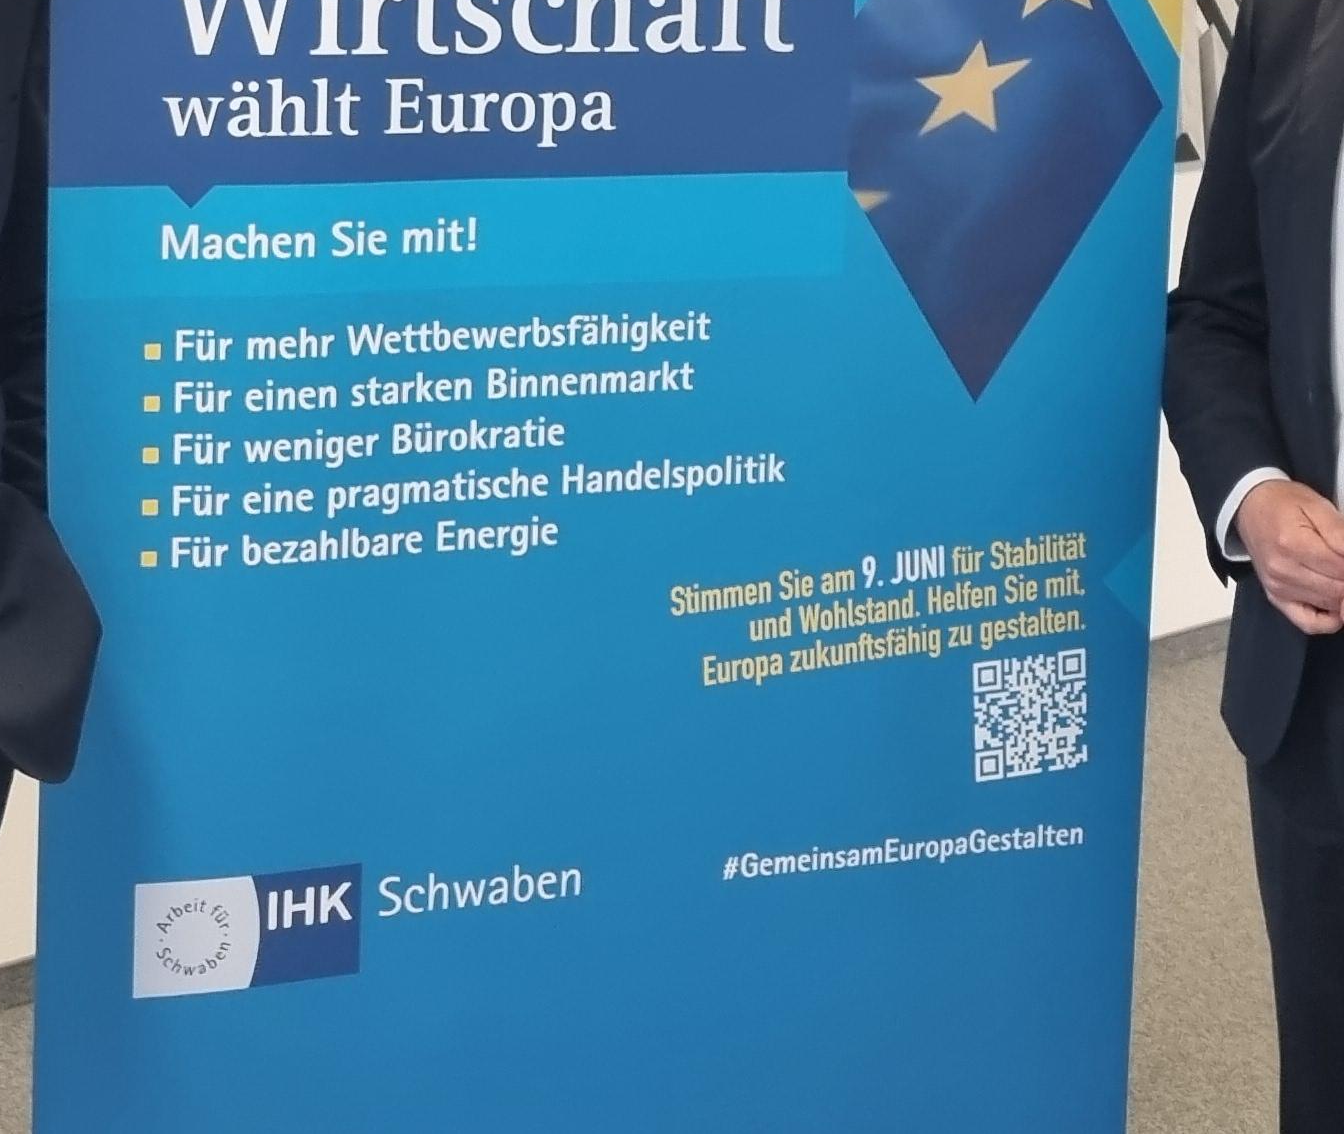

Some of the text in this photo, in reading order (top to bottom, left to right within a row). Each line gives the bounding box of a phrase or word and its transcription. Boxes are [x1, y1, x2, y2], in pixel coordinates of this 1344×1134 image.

[164, 78, 615, 147] wählt Europa
[161, 217, 478, 260] Machen Sie mit!
[175, 311, 711, 362] Für mehr Wettbewerbsfähigkeit
[174, 362, 694, 414] Für einen starken Binnenmarkt
[174, 418, 566, 468] Für weniger Bürokratie
[172, 455, 786, 518] Für eine pragmatische Handelspolitik
[171, 518, 559, 569] Für bezahlbare Energie
[671, 533, 1087, 616] Stimmen Sie am 9. JUNI für Stabilität
[749, 608, 792, 641] und
[798, 592, 920, 633] Wohlstand.
[928, 583, 997, 615] Helfen
[1004, 575, 1038, 603] Sie
[703, 608, 1086, 687] Europa zukunftsfähig zu gestalten.
[723, 825, 1084, 881] #GemeinsamEuropaGestalten
[156, 898, 230, 934] Arbeit für
[267, 865, 582, 931] IHK Schwaben
[156, 942, 231, 976] Schwaben
